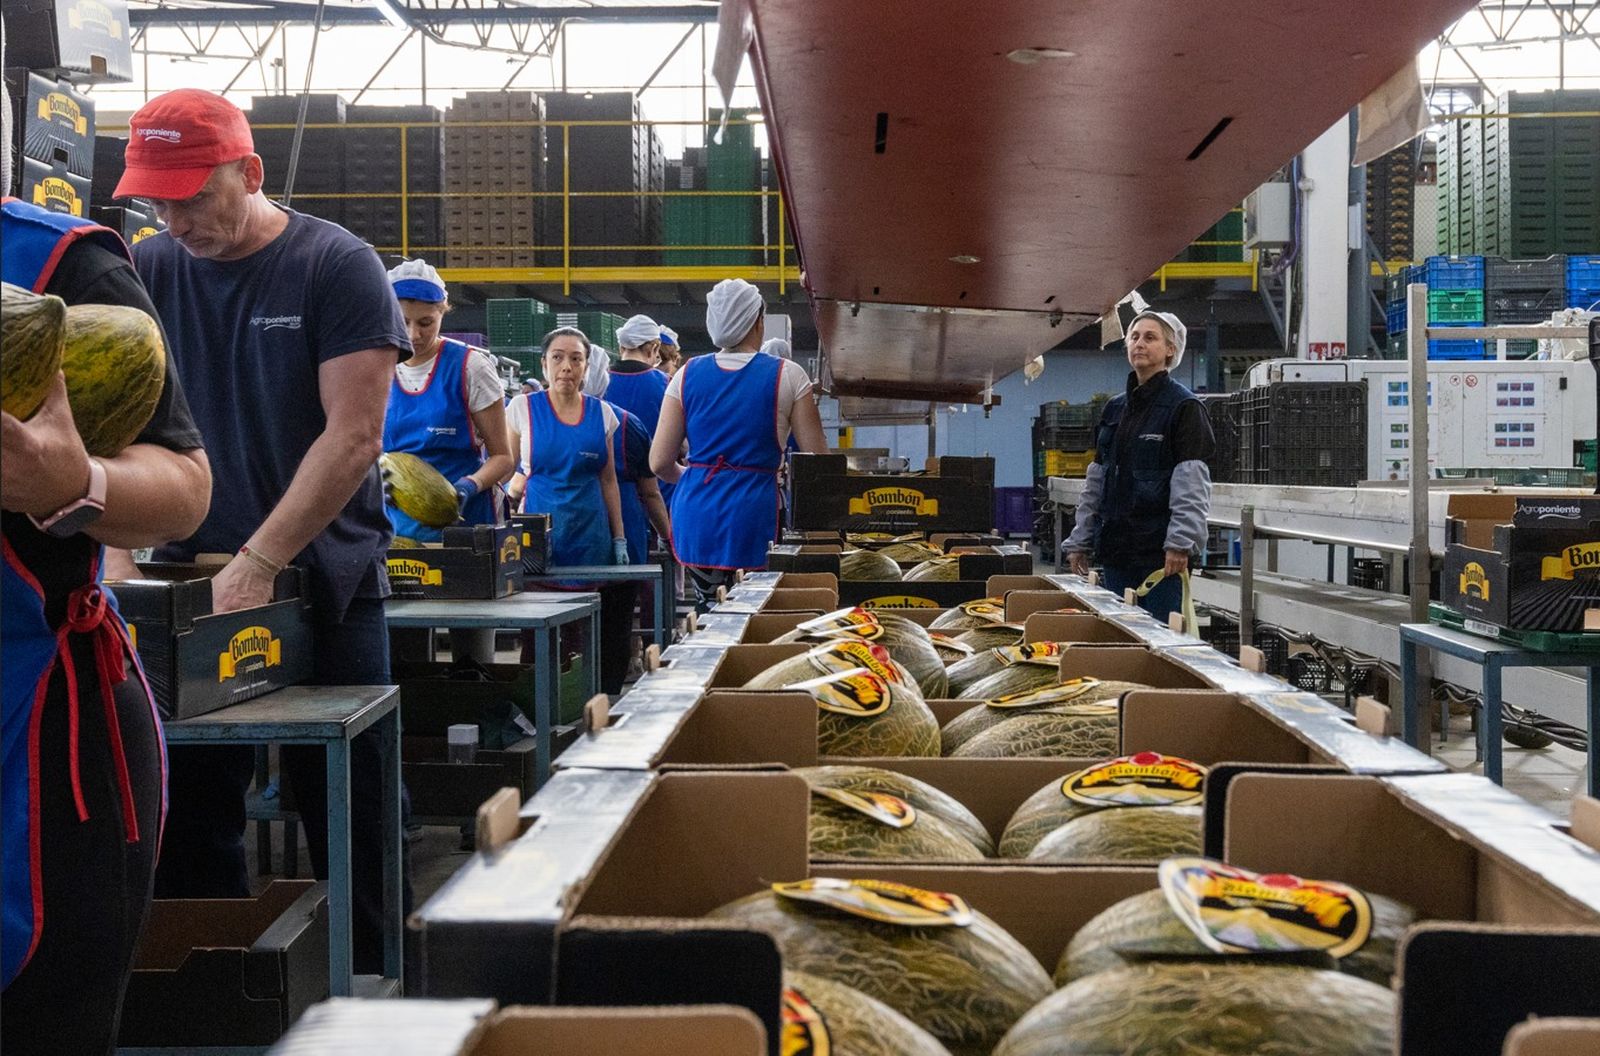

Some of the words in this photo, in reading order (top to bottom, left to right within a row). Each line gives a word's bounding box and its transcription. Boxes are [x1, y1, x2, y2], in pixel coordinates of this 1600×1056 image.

[249, 315, 301, 326] Agroponiente
[867, 489, 920, 506] Bombón
[1519, 504, 1581, 515] Agroponiente
[386, 560, 425, 577] ombón
[232, 629, 269, 661] Bombón
